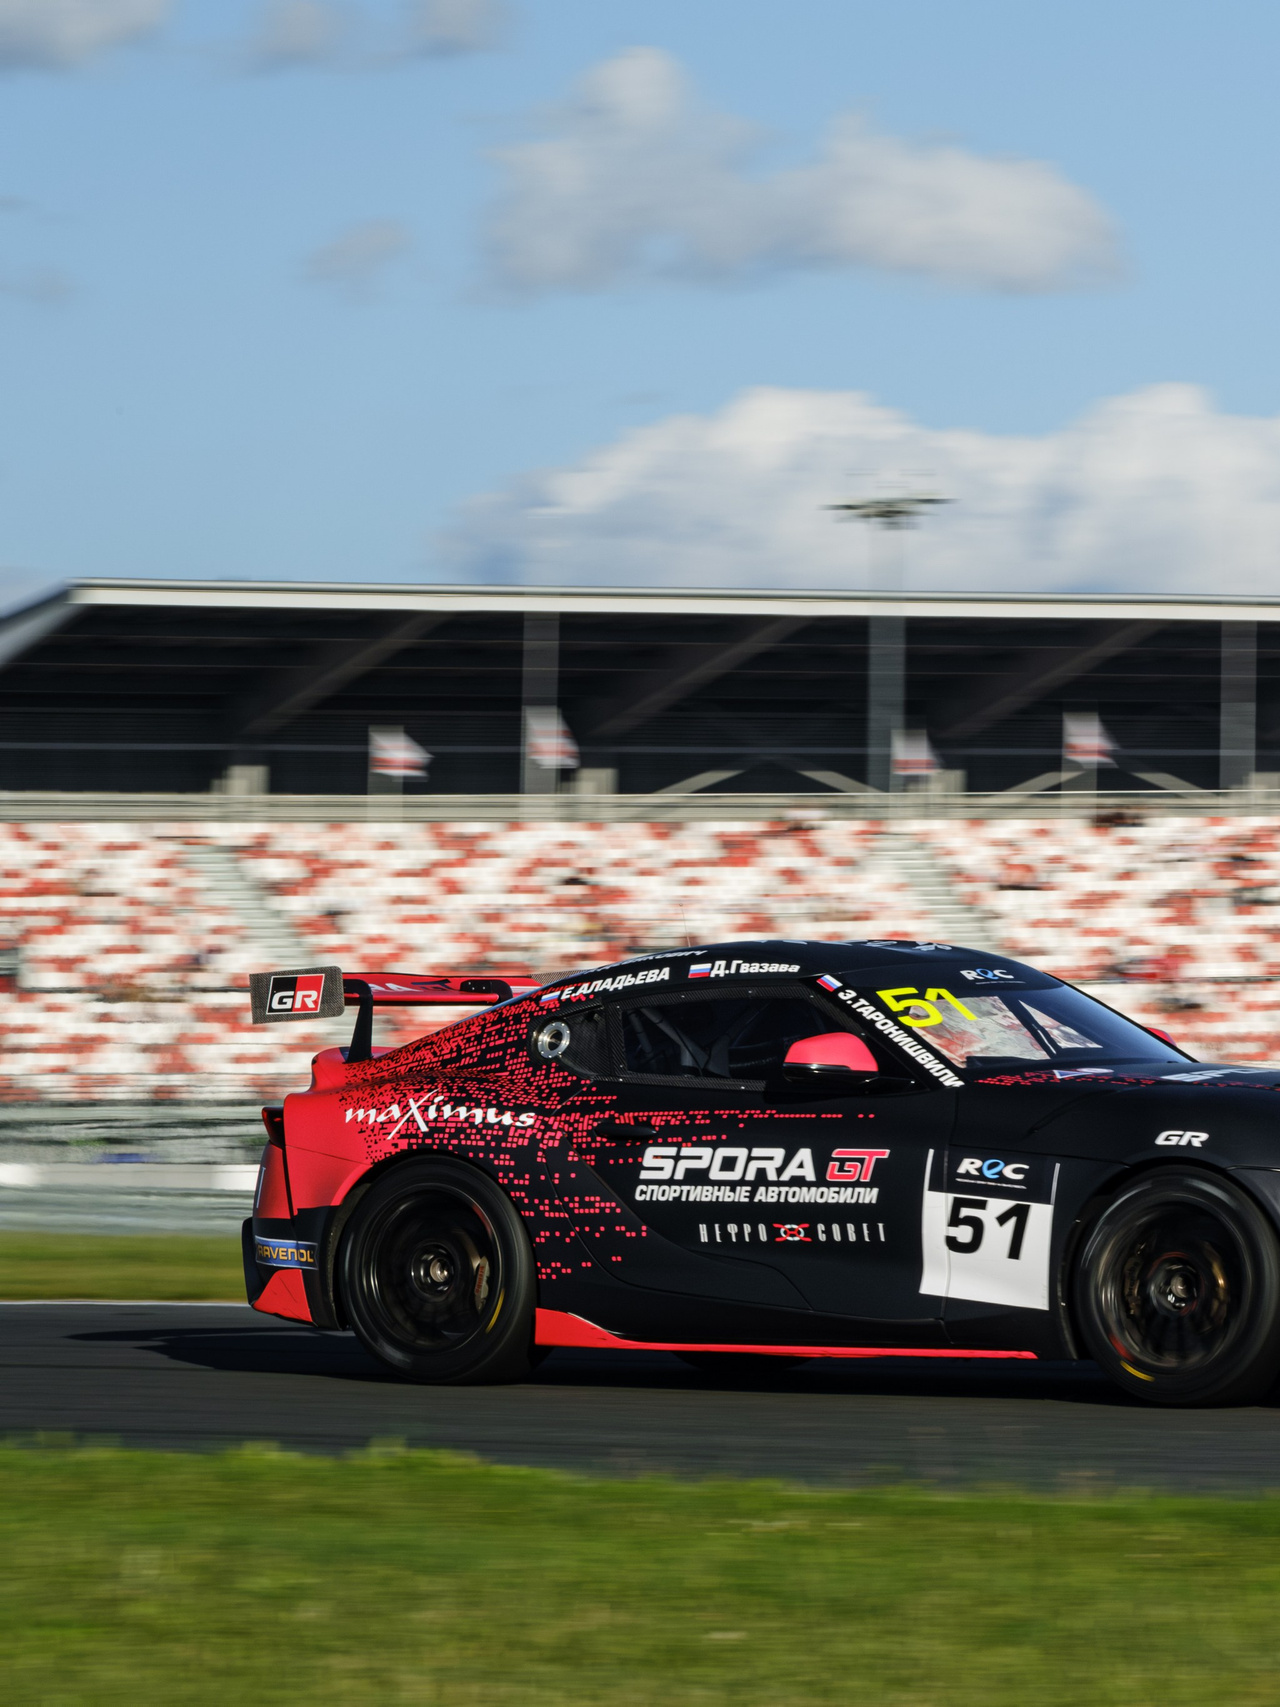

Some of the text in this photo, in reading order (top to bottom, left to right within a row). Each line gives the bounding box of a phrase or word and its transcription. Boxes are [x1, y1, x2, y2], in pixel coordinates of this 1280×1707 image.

[710, 960, 801, 978] Д.Гвазава
[560, 967, 670, 1000] Е.АЛАДЬЕВА
[271, 990, 318, 1010] GR
[876, 987, 978, 1028] 51
[1155, 1130, 1209, 1147] GR
[639, 1147, 890, 1182] SPORA GT
[635, 1185, 879, 1204] СПОРТИВНЫЕ АВТОМОБИЛИ
[817, 1223, 886, 1242] СОВЕТ
[945, 1196, 1031, 1260] 51
[257, 1245, 314, 1263] RAVENOL
